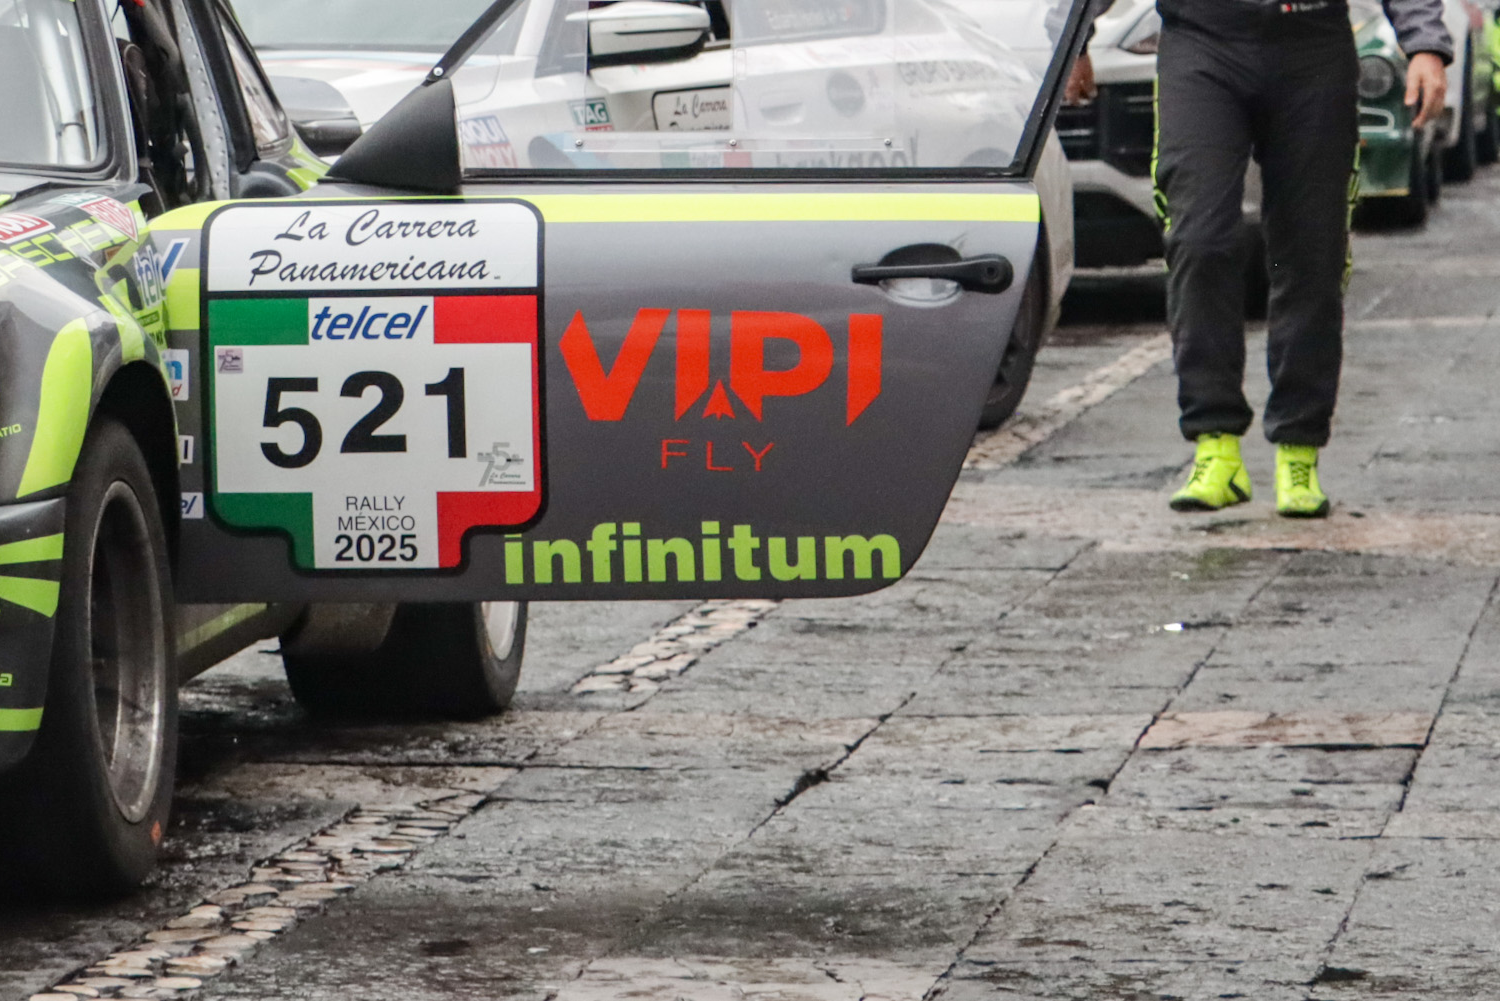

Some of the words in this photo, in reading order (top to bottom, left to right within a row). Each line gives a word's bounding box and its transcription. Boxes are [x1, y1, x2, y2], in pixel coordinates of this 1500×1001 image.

[274, 210, 330, 241] La
[345, 208, 480, 247] Carrera
[248, 249, 491, 287] Panamericana
[311, 305, 429, 341] telcel
[559, 308, 883, 427] VIPI
[260, 367, 467, 469] 521
[660, 438, 775, 472] FLY
[337, 512, 416, 531] MÉXICO
[345, 495, 405, 511] RALLY
[334, 533, 418, 562] 2025
[503, 521, 901, 584] infinitum
